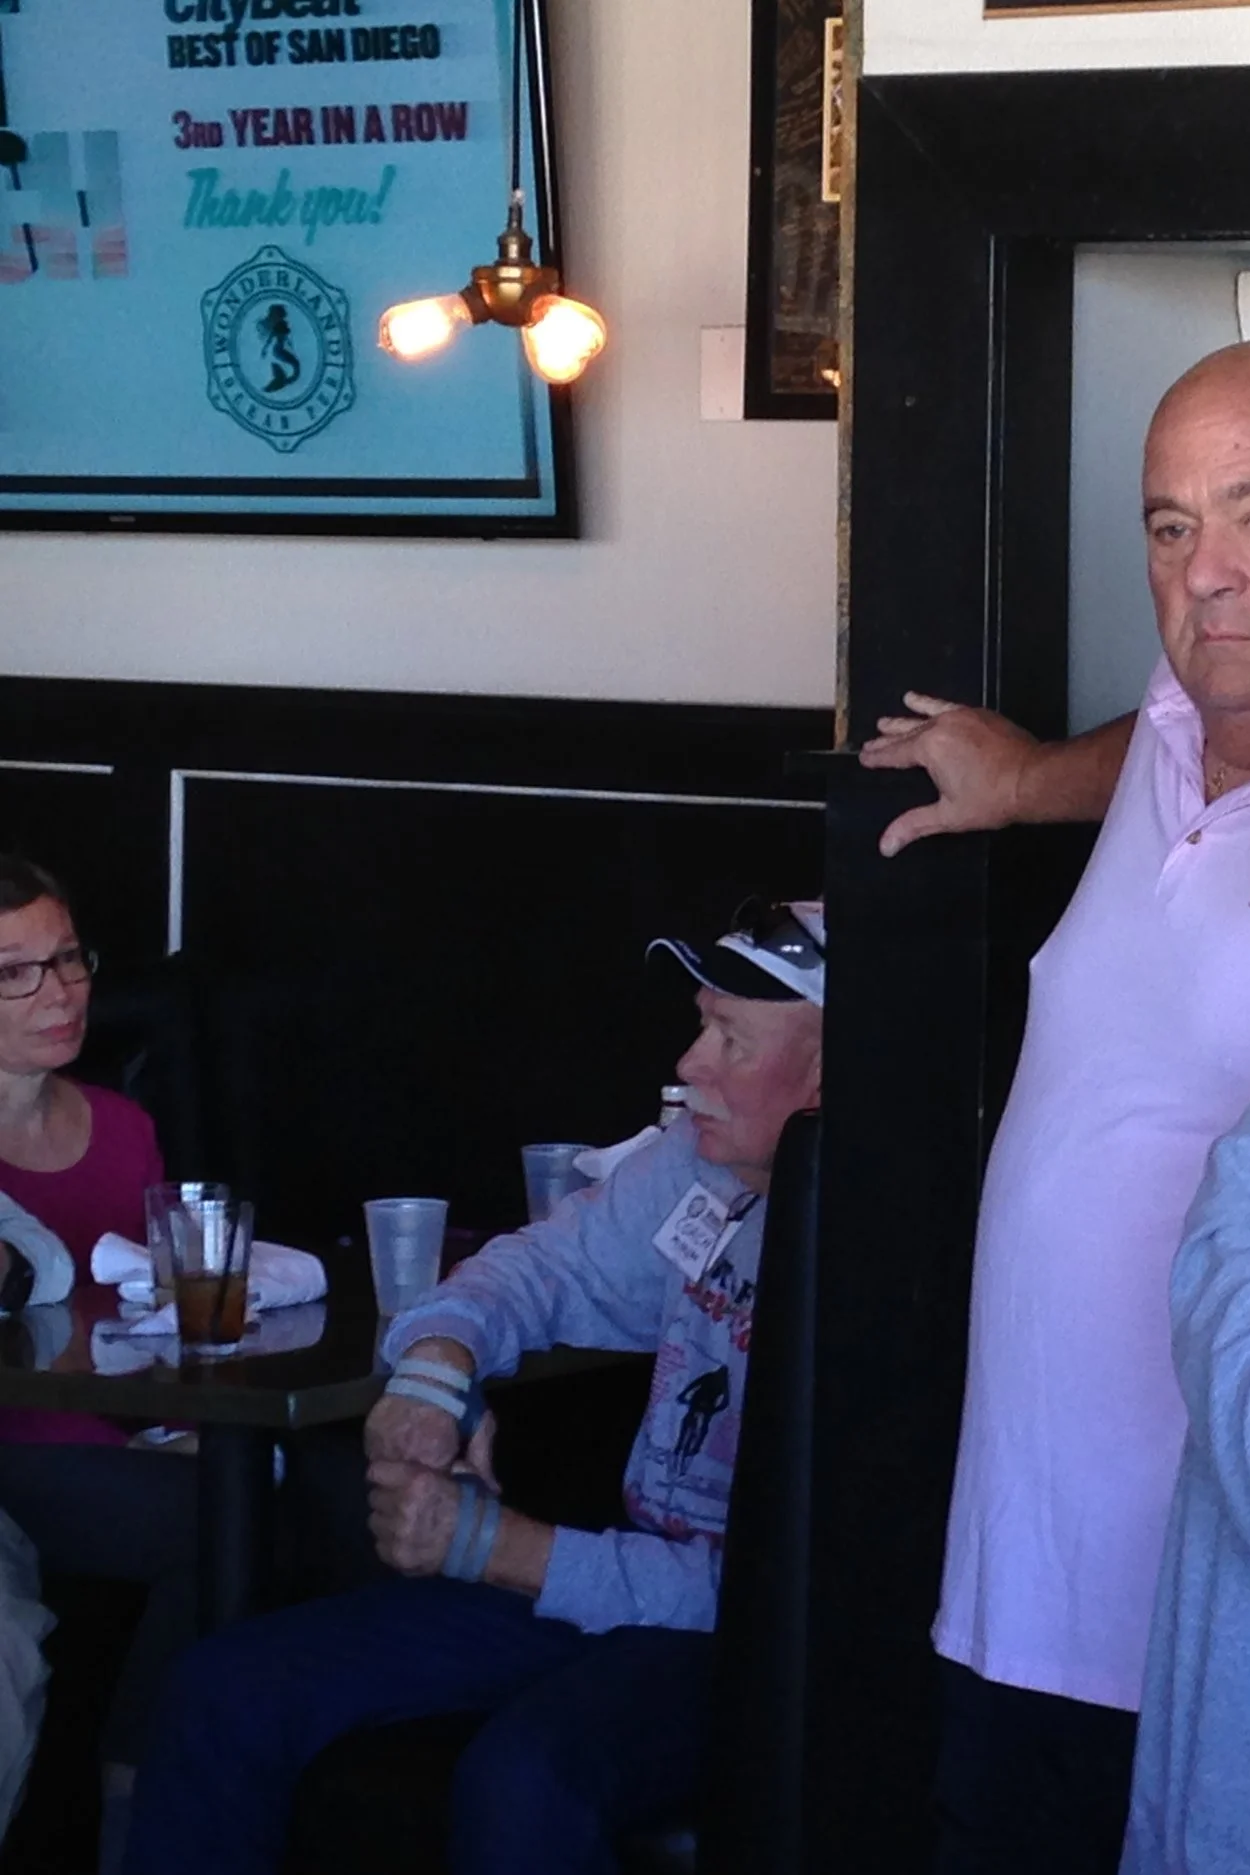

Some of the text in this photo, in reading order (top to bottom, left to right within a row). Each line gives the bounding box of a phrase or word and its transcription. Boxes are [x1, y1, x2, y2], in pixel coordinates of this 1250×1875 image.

[167, 23, 440, 69] BEST OF SAN DIEGO
[228, 107, 315, 148] YEAR
[320, 105, 355, 145] IN
[363, 104, 386, 144] A
[391, 101, 469, 142] ROW
[183, 163, 397, 246] Thank you!
